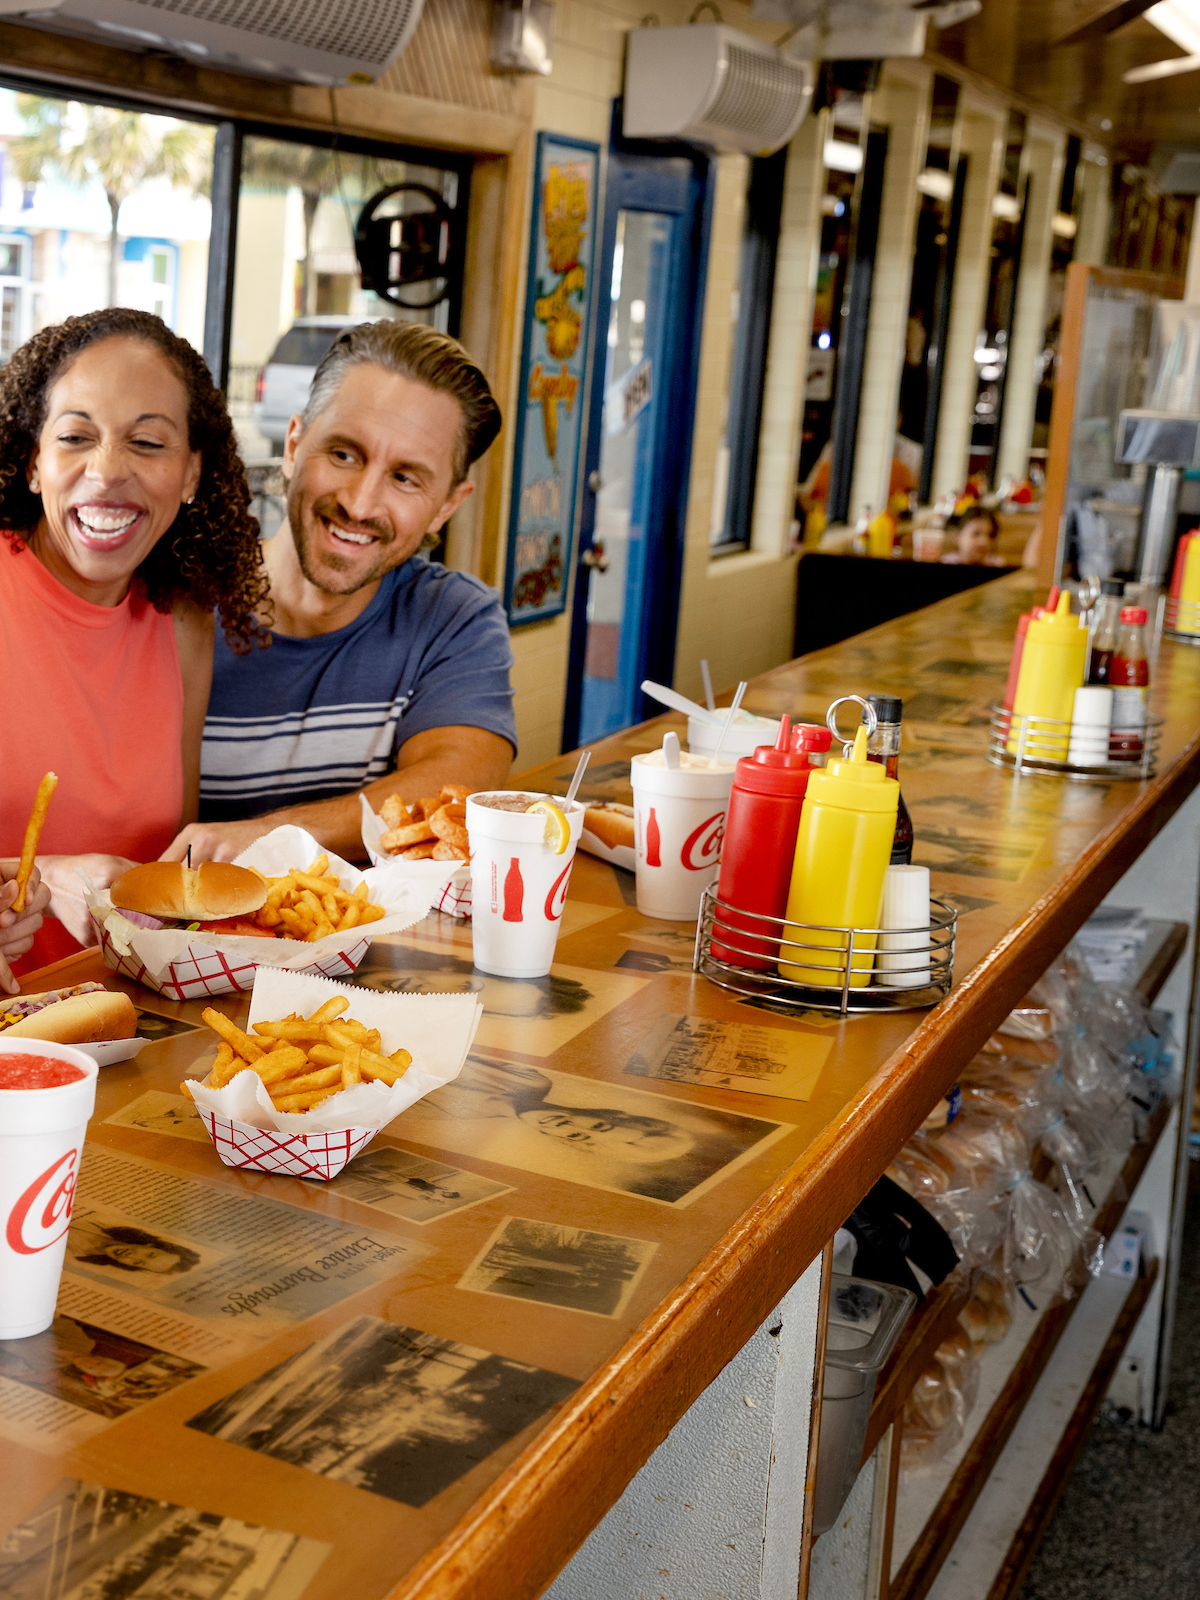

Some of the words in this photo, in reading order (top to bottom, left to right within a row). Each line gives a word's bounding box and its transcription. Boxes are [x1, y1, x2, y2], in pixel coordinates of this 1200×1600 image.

[315, 1236, 389, 1271] Eunice
[374, 1244, 408, 1262] Noted
[221, 1265, 330, 1317] Burroughs
